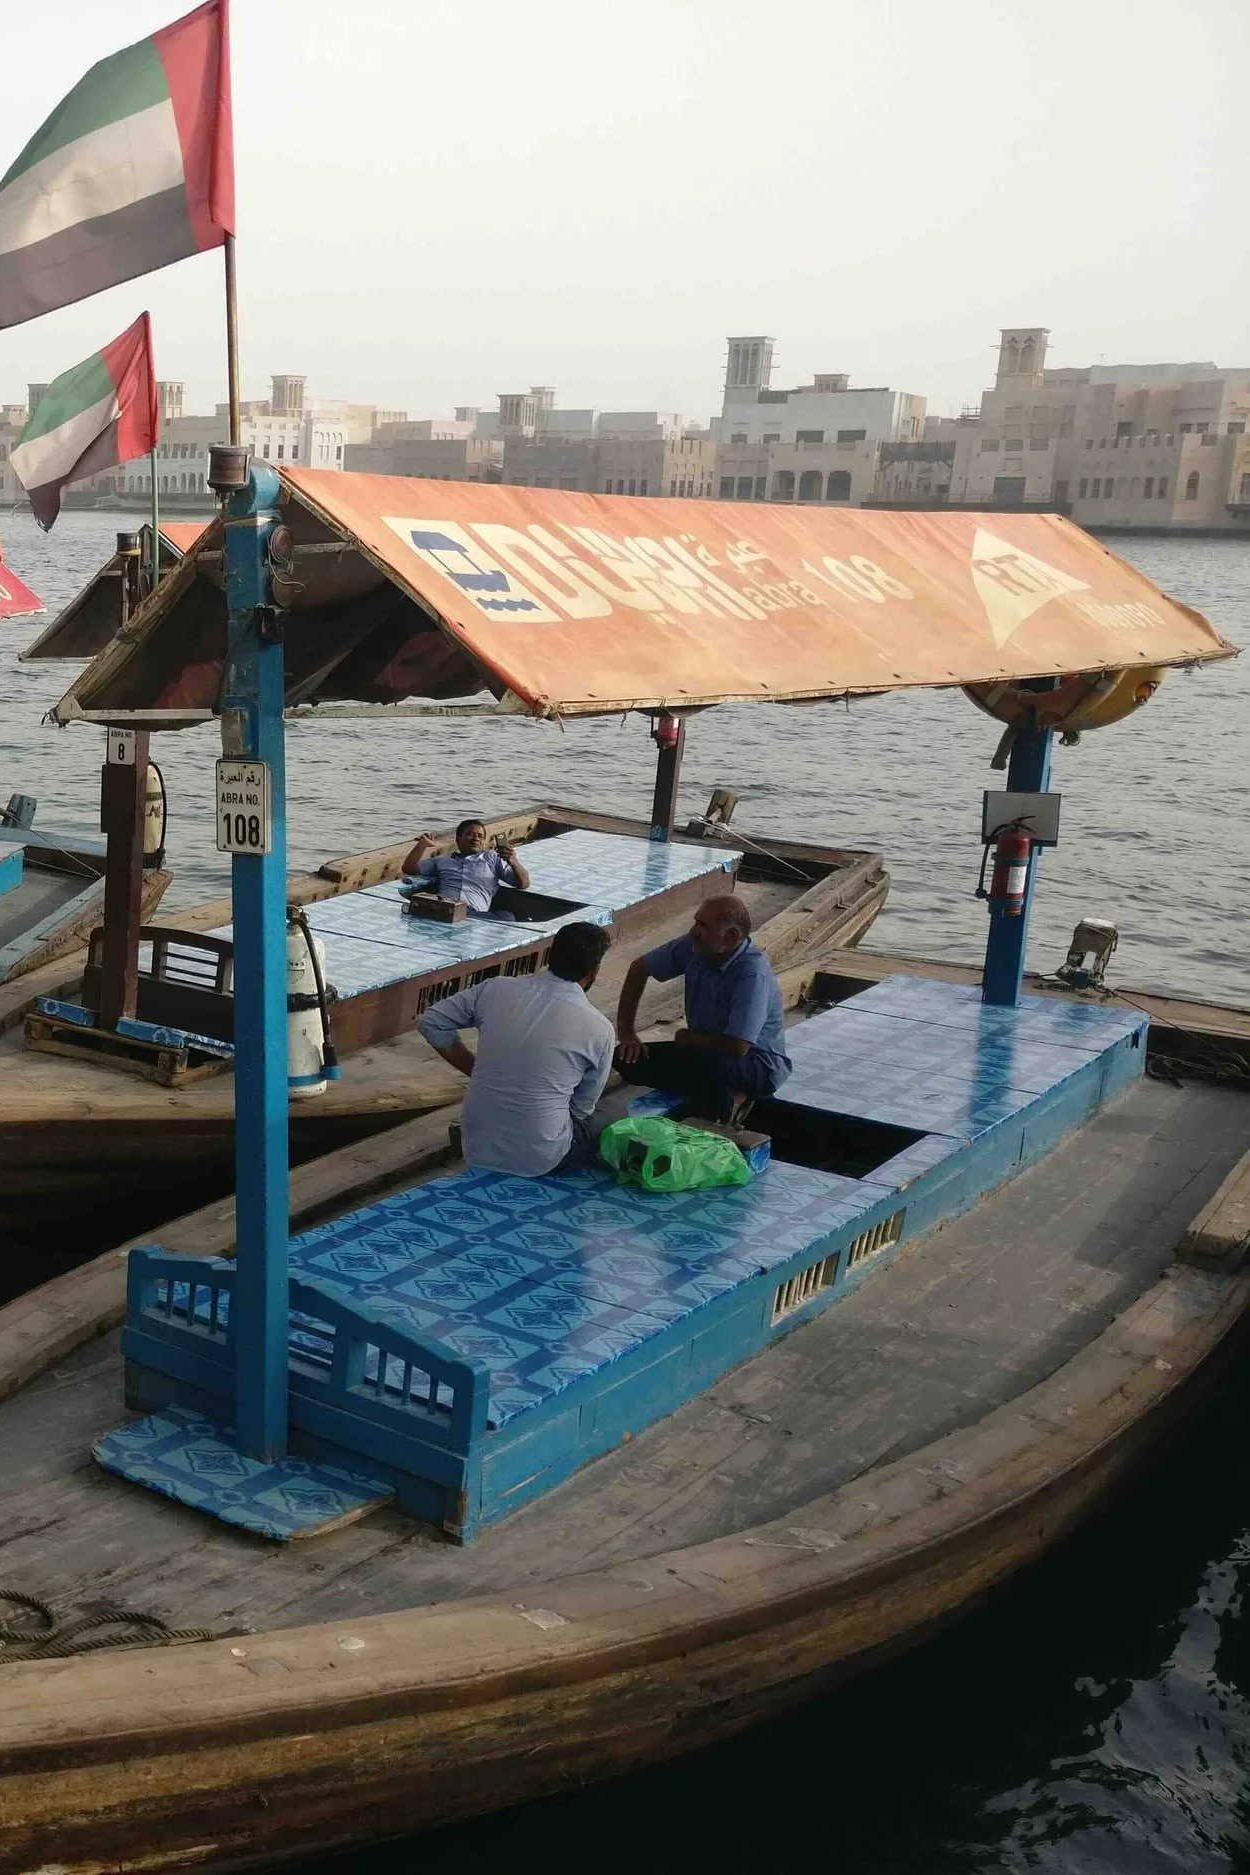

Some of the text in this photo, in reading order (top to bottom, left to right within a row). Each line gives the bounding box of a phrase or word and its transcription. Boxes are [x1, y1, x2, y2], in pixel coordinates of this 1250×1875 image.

[741, 578, 825, 611] abra
[800, 554, 914, 604] 108
[117, 742, 125, 761] 8
[220, 792, 261, 807] ABRA NO.
[222, 812, 260, 848] 108
